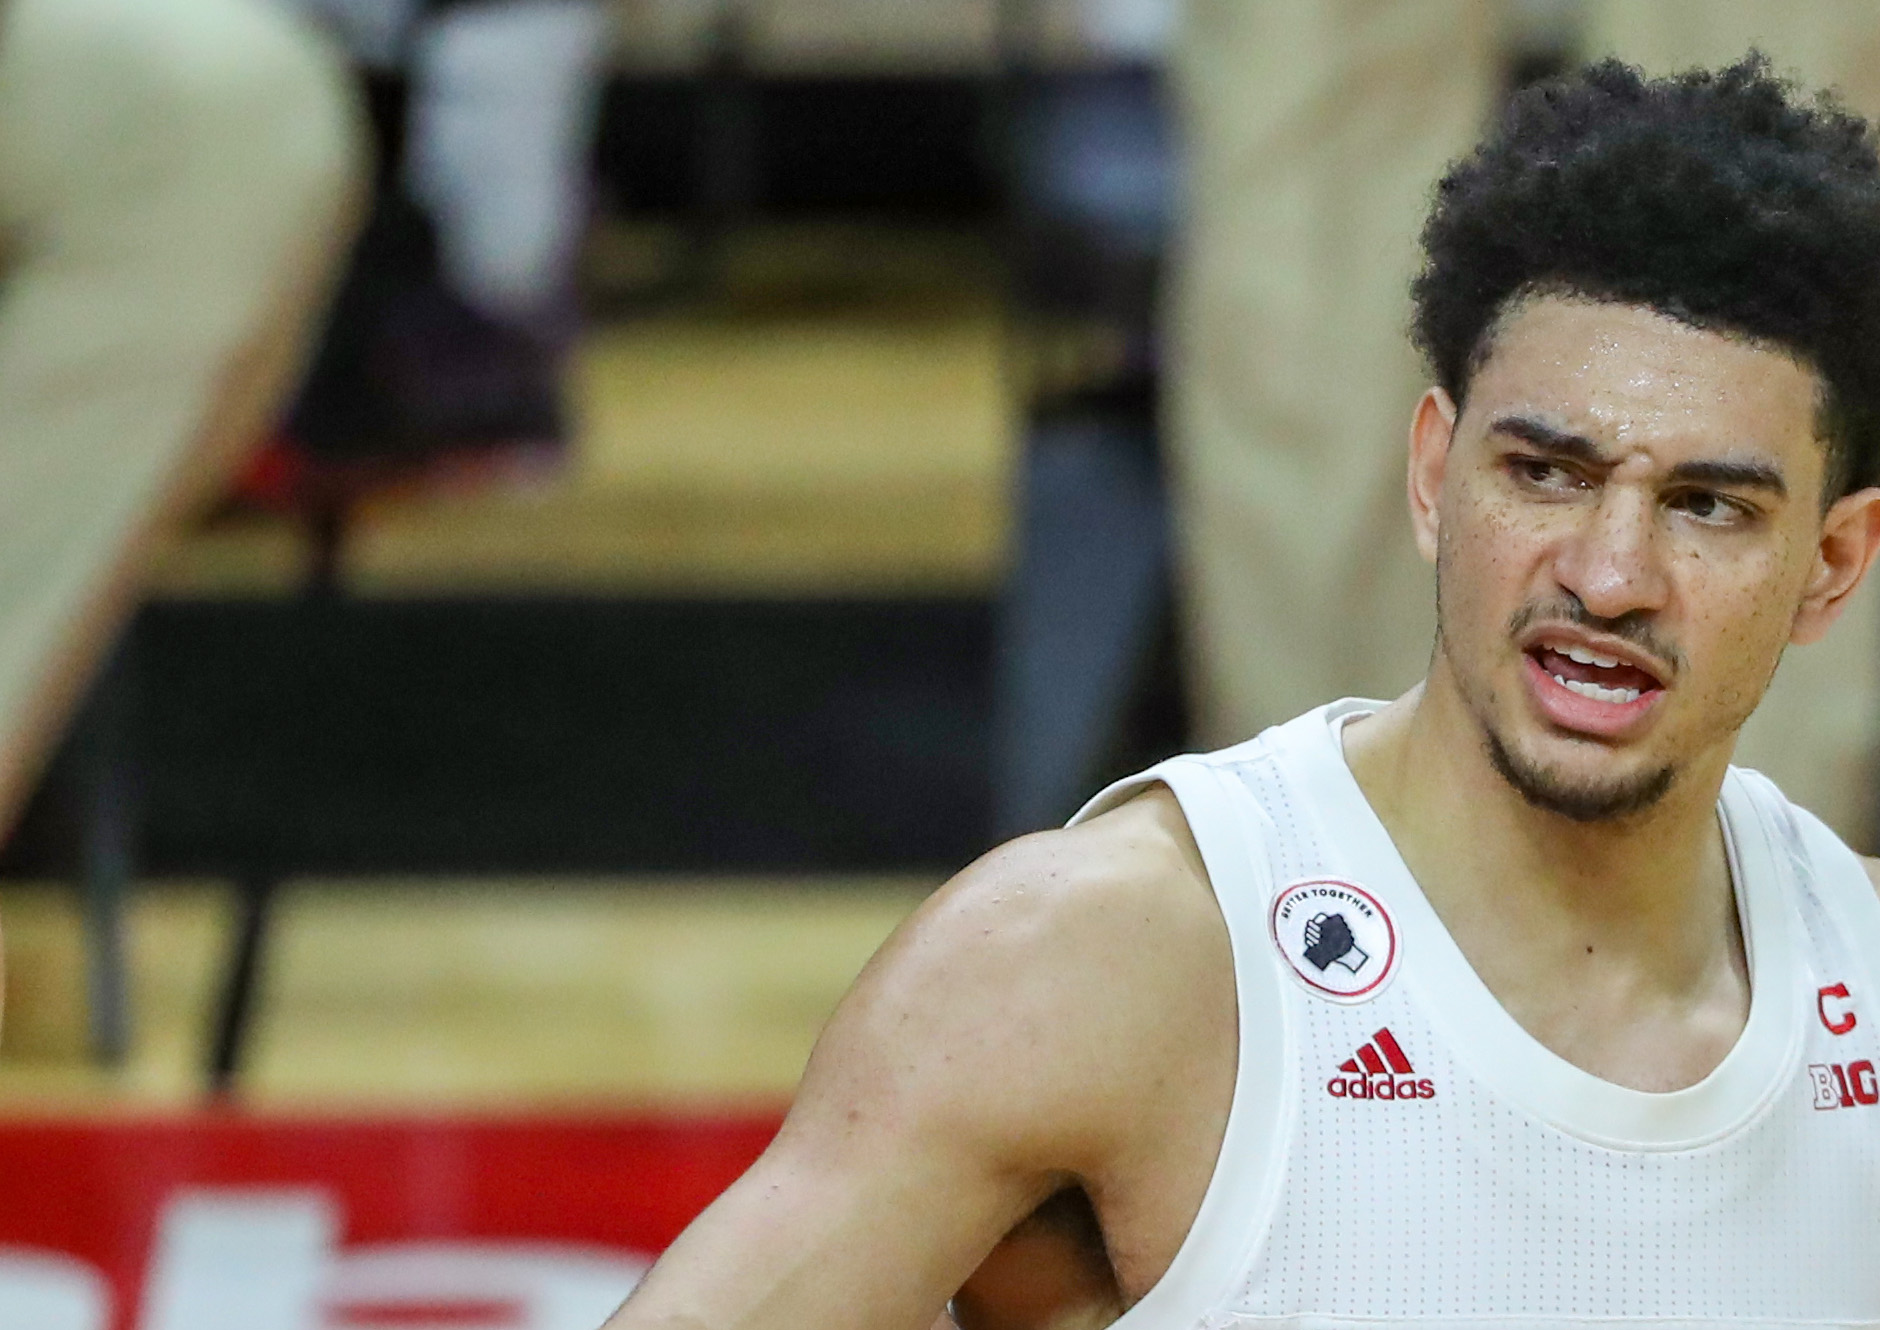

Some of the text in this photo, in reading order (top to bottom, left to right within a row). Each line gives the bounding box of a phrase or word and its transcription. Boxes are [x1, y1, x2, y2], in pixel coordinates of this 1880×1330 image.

[1311, 888, 1373, 918] TOGETHER
[1817, 982, 1857, 1036] C
[1327, 1072, 1436, 1101] adidas
